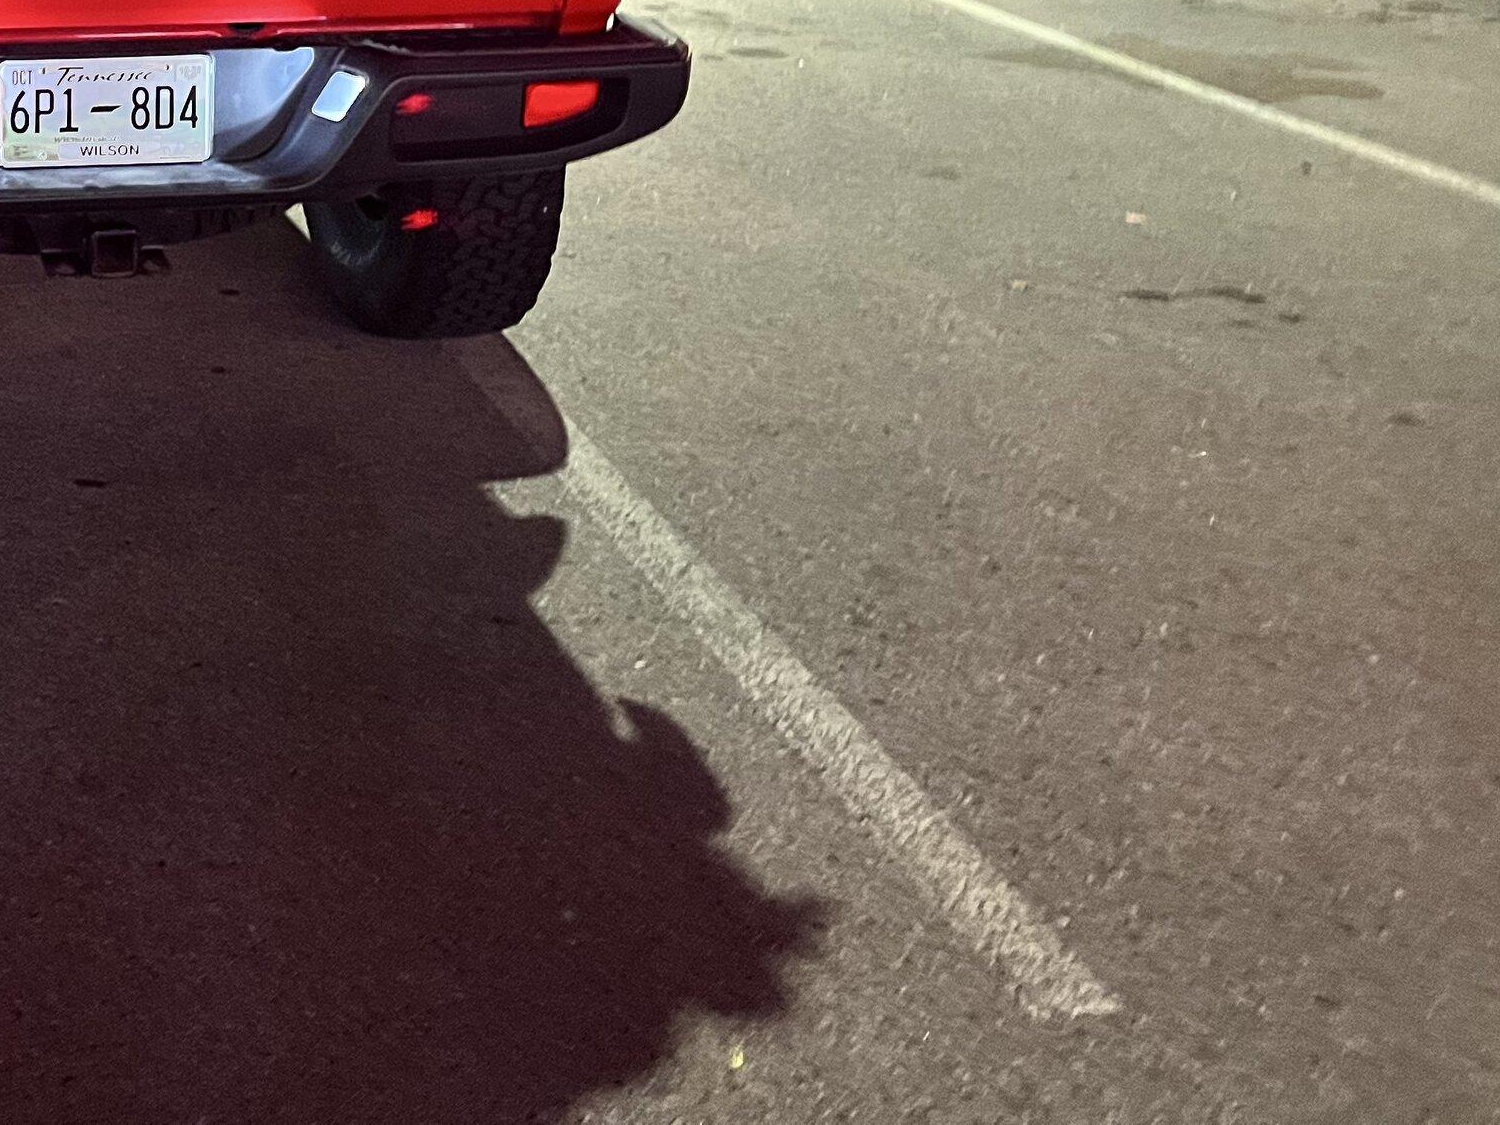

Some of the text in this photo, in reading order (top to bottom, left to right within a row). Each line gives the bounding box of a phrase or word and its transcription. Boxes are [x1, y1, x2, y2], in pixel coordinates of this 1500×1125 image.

[12, 66, 153, 86] OCT Tennessee
[80, 144, 140, 156] WILSON
